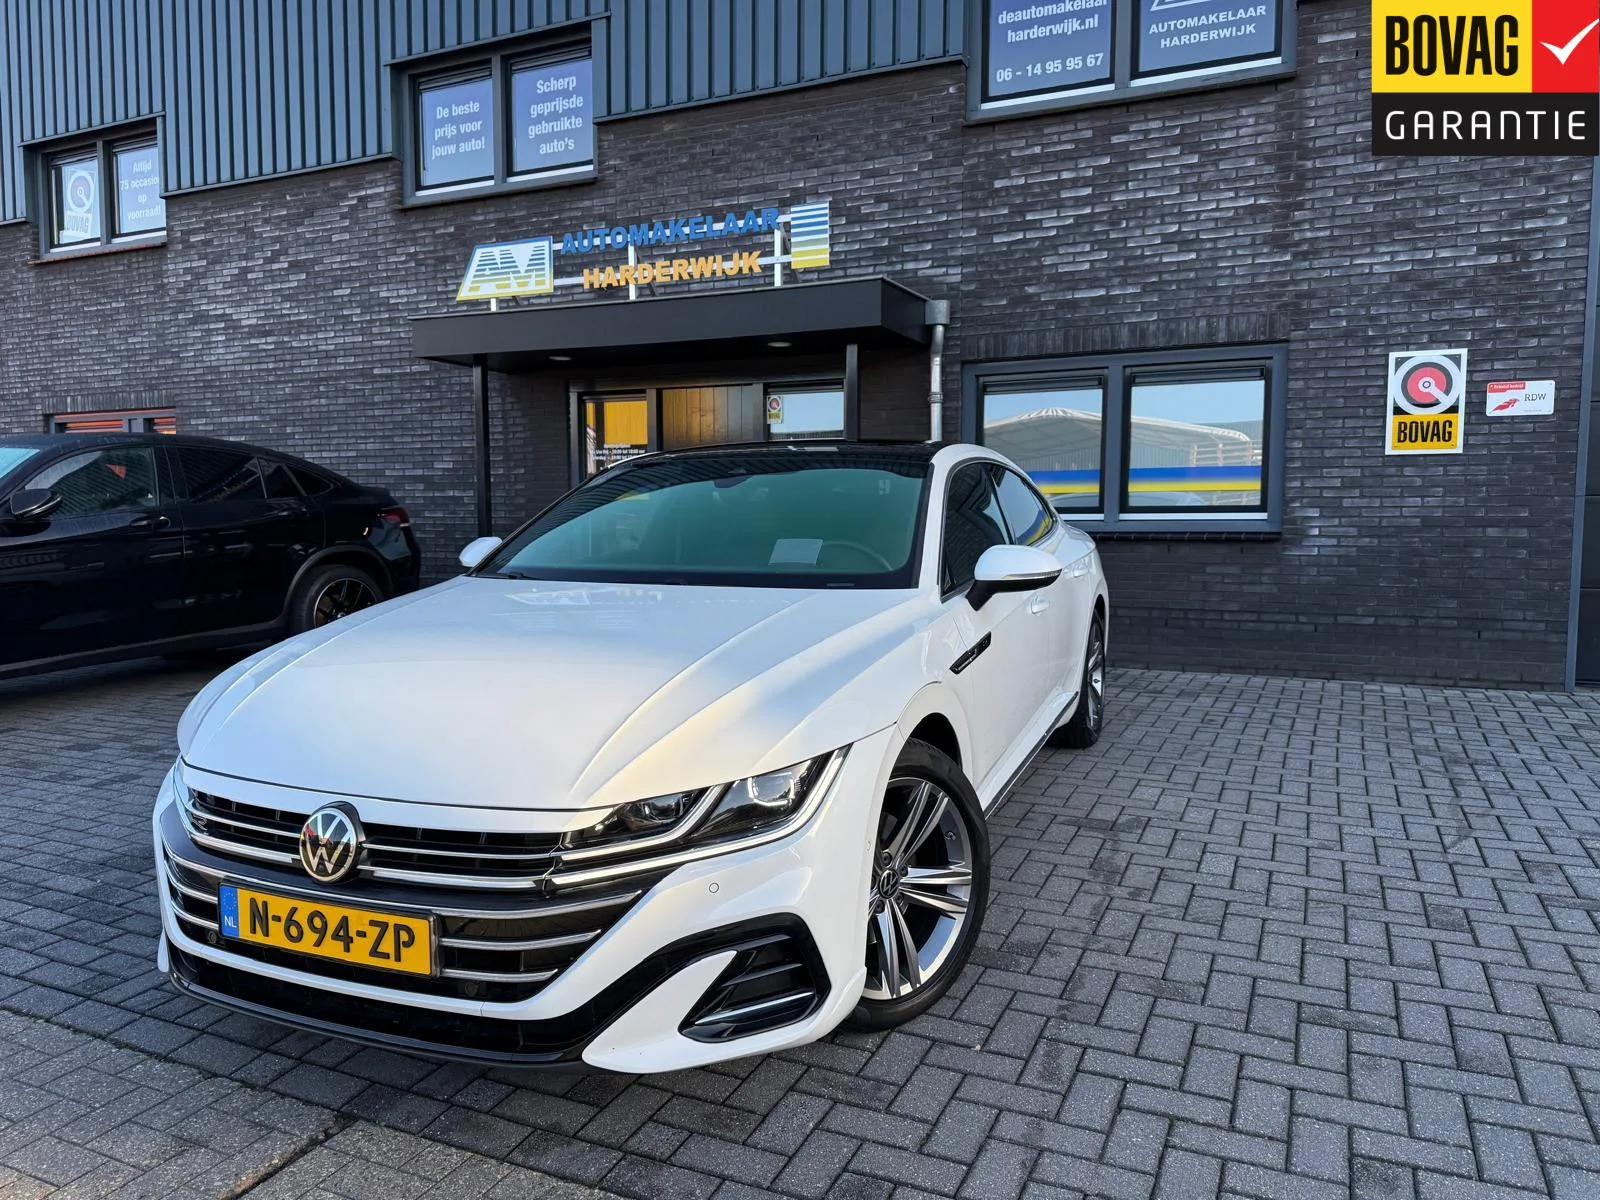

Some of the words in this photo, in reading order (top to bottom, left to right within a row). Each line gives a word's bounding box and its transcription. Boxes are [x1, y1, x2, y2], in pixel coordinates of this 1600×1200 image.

[1007, 14, 1099, 42] harderwijk.nl
[1149, 5, 1266, 34] AUTOMAKELAAR
[1160, 23, 1257, 48] HARDERWIJK
[996, 68, 1013, 82] 06
[1026, 63, 1042, 77] 14
[1045, 59, 1062, 74] 95
[1066, 56, 1083, 71] 95
[1086, 52, 1104, 67] 67
[536, 76, 577, 94] Scherp
[436, 106, 449, 119] De
[452, 101, 480, 117] beste
[530, 95, 584, 118] geprijsde
[434, 123, 457, 140] prijs
[459, 120, 482, 133] voor
[528, 115, 583, 139] gebruikte
[431, 144, 456, 159] jouw
[458, 136, 485, 152] auto!
[539, 137, 575, 154] auto's
[138, 194, 147, 204] op
[560, 207, 780, 255] AUTOMAKELAAR
[583, 250, 762, 289] HARDERWIJK
[1524, 393, 1547, 402] RDW
[1397, 419, 1453, 443] BOVAG
[224, 915, 237, 929] NL
[249, 897, 415, 963] N-694-ZP
